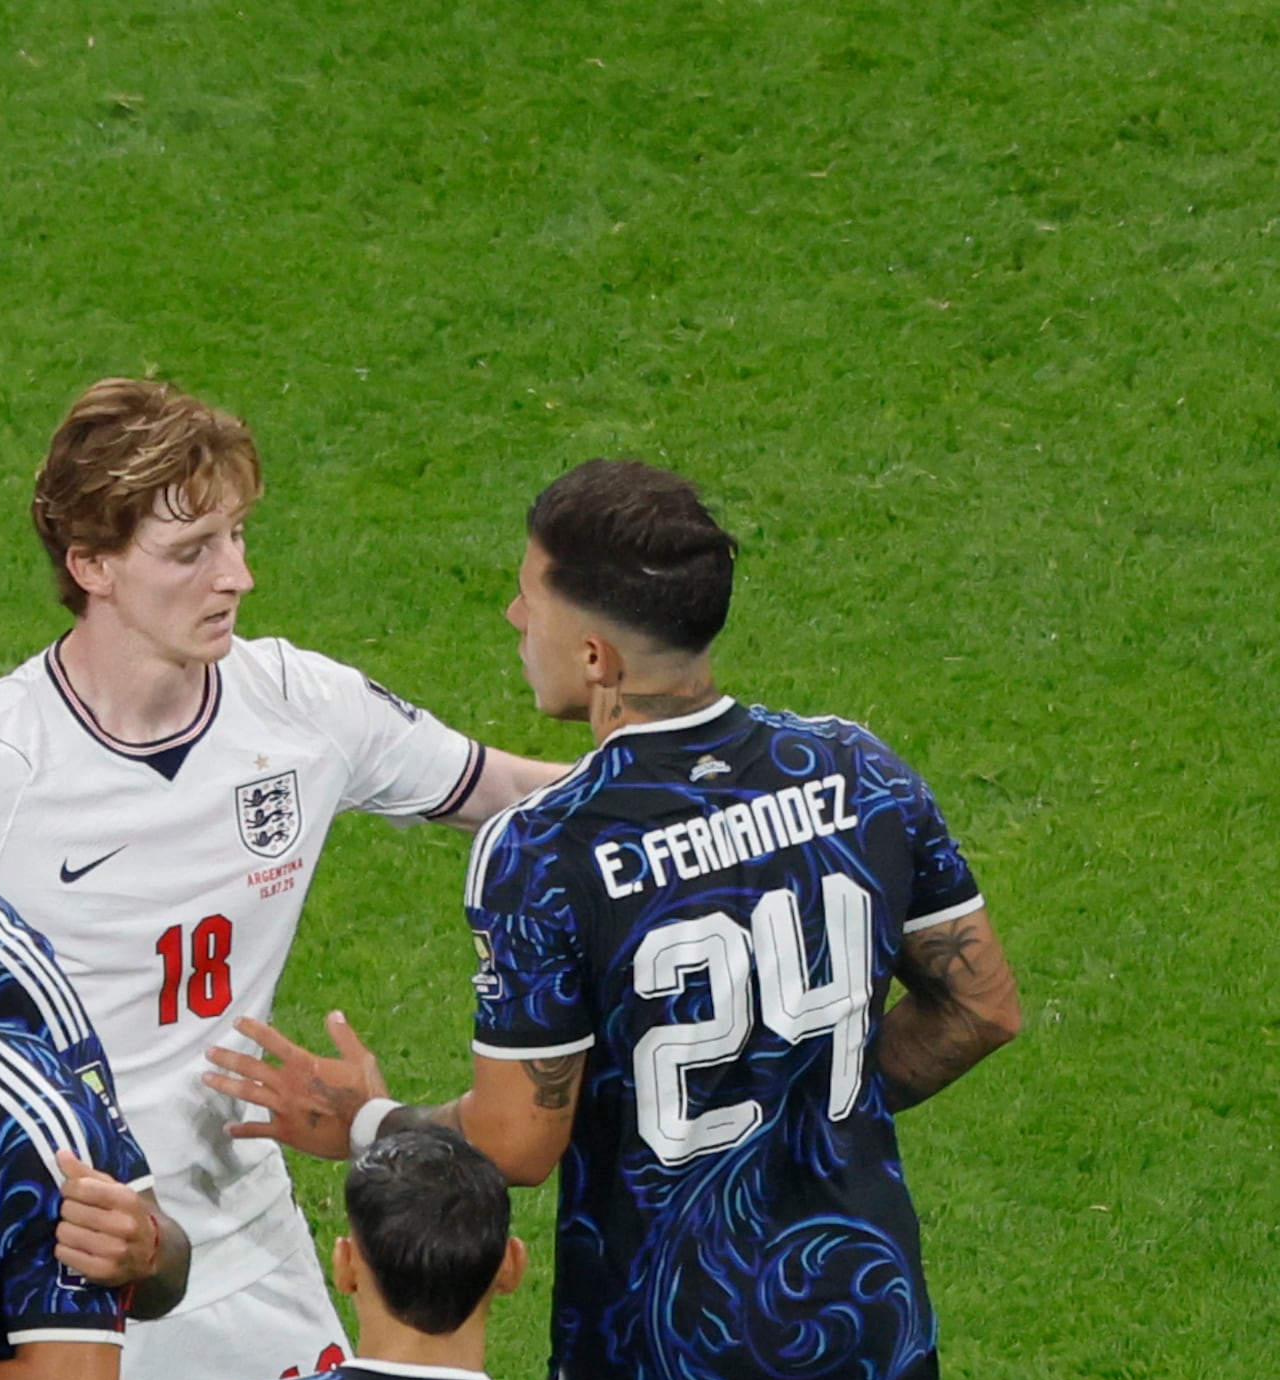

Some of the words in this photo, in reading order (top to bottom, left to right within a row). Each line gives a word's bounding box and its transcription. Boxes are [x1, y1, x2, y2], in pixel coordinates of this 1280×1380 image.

[247, 857, 303, 888] ARGENTINA
[156, 914, 233, 1025] 18
[632, 872, 873, 1167] 24
